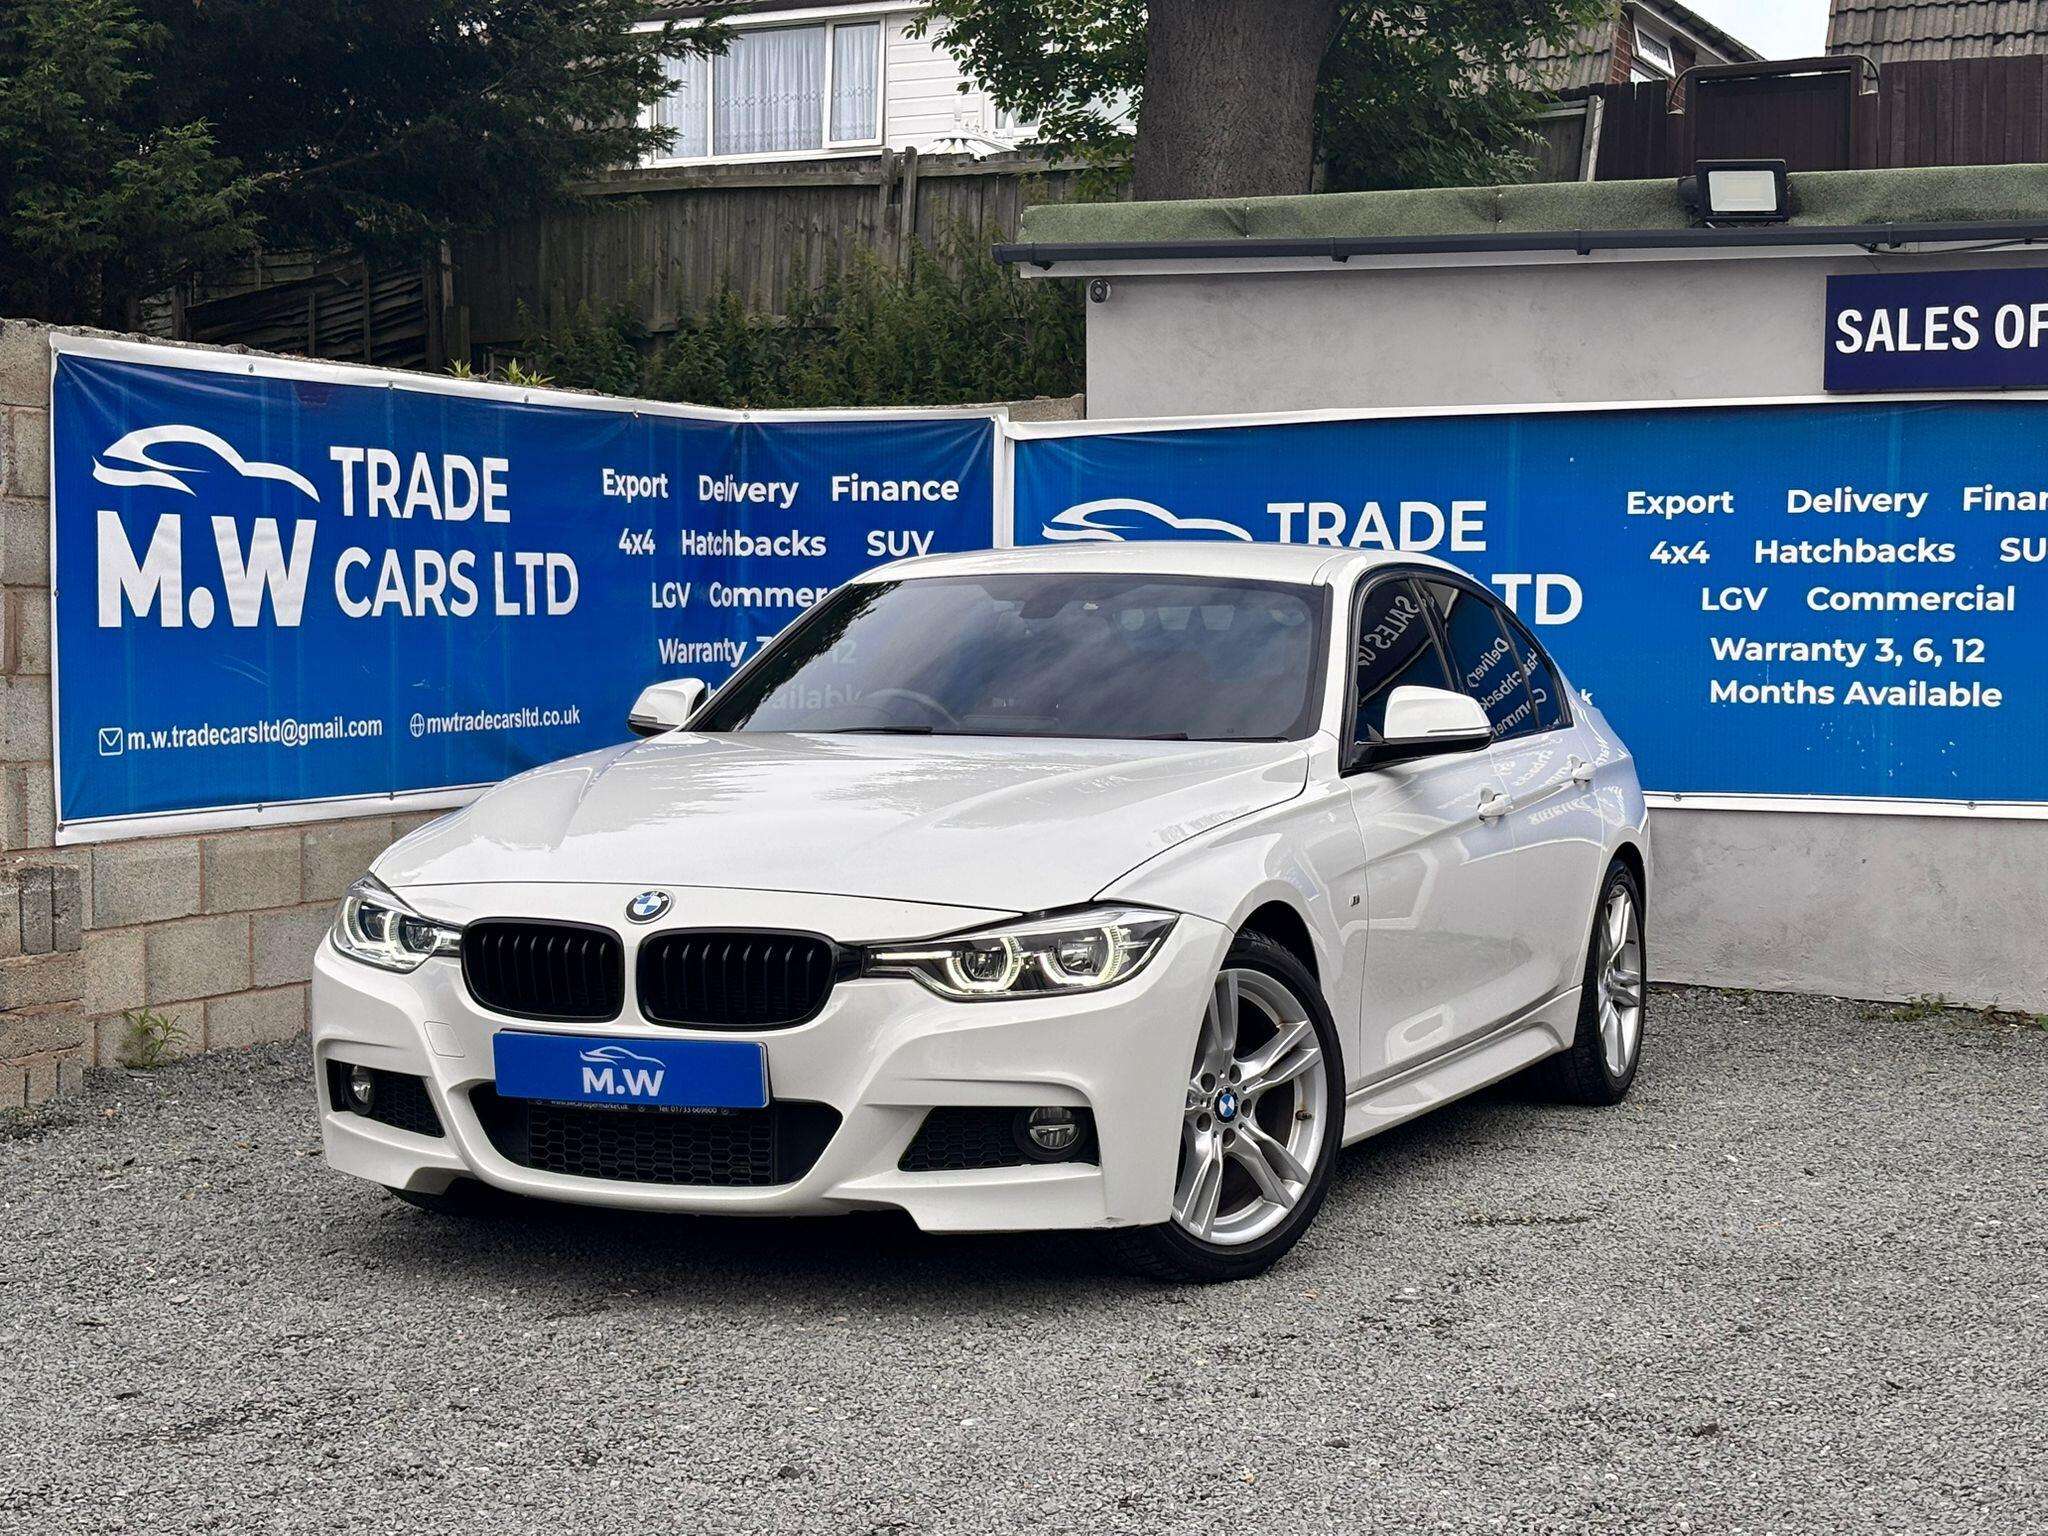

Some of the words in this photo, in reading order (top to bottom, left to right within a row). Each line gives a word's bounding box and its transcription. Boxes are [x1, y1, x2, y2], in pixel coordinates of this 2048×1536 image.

[1836, 306, 1979, 353] SALES
[1995, 303, 2048, 349] OF
[330, 446, 510, 522] TRADE
[602, 469, 668, 503] Export
[699, 475, 798, 509] Delivery
[832, 473, 959, 502] Finance
[1627, 491, 1733, 520] Export
[1787, 486, 1928, 518] Delivery
[618, 528, 656, 556] 4x4
[682, 529, 827, 557] Hatchbacks
[867, 530, 935, 557] SUV
[1267, 501, 1487, 551] TRADE
[1650, 540, 1710, 564] 4x4
[1755, 537, 1956, 564] Hatchbacks
[2000, 537, 2047, 563] SU
[98, 510, 316, 628] M.W
[335, 546, 477, 618] CARS
[494, 551, 579, 616] LTD
[652, 583, 691, 609] LGV
[709, 582, 836, 609] Commer
[1492, 573, 1583, 625] TD
[1702, 587, 1768, 611] LGV
[1806, 584, 2015, 611] Commercial
[659, 638, 748, 668] Warranty
[1711, 637, 1867, 667] Warranty
[1875, 638, 1903, 667] 3,
[1914, 638, 1942, 667] 6,
[1952, 638, 1985, 663] 12
[1711, 679, 1835, 705] Months
[1843, 679, 2003, 708] Available
[128, 716, 383, 750] m.w.tradecarsltd@gmail.com
[427, 704, 581, 735] mwtradecarsltd.co.uk
[583, 1067, 666, 1097] M.W
